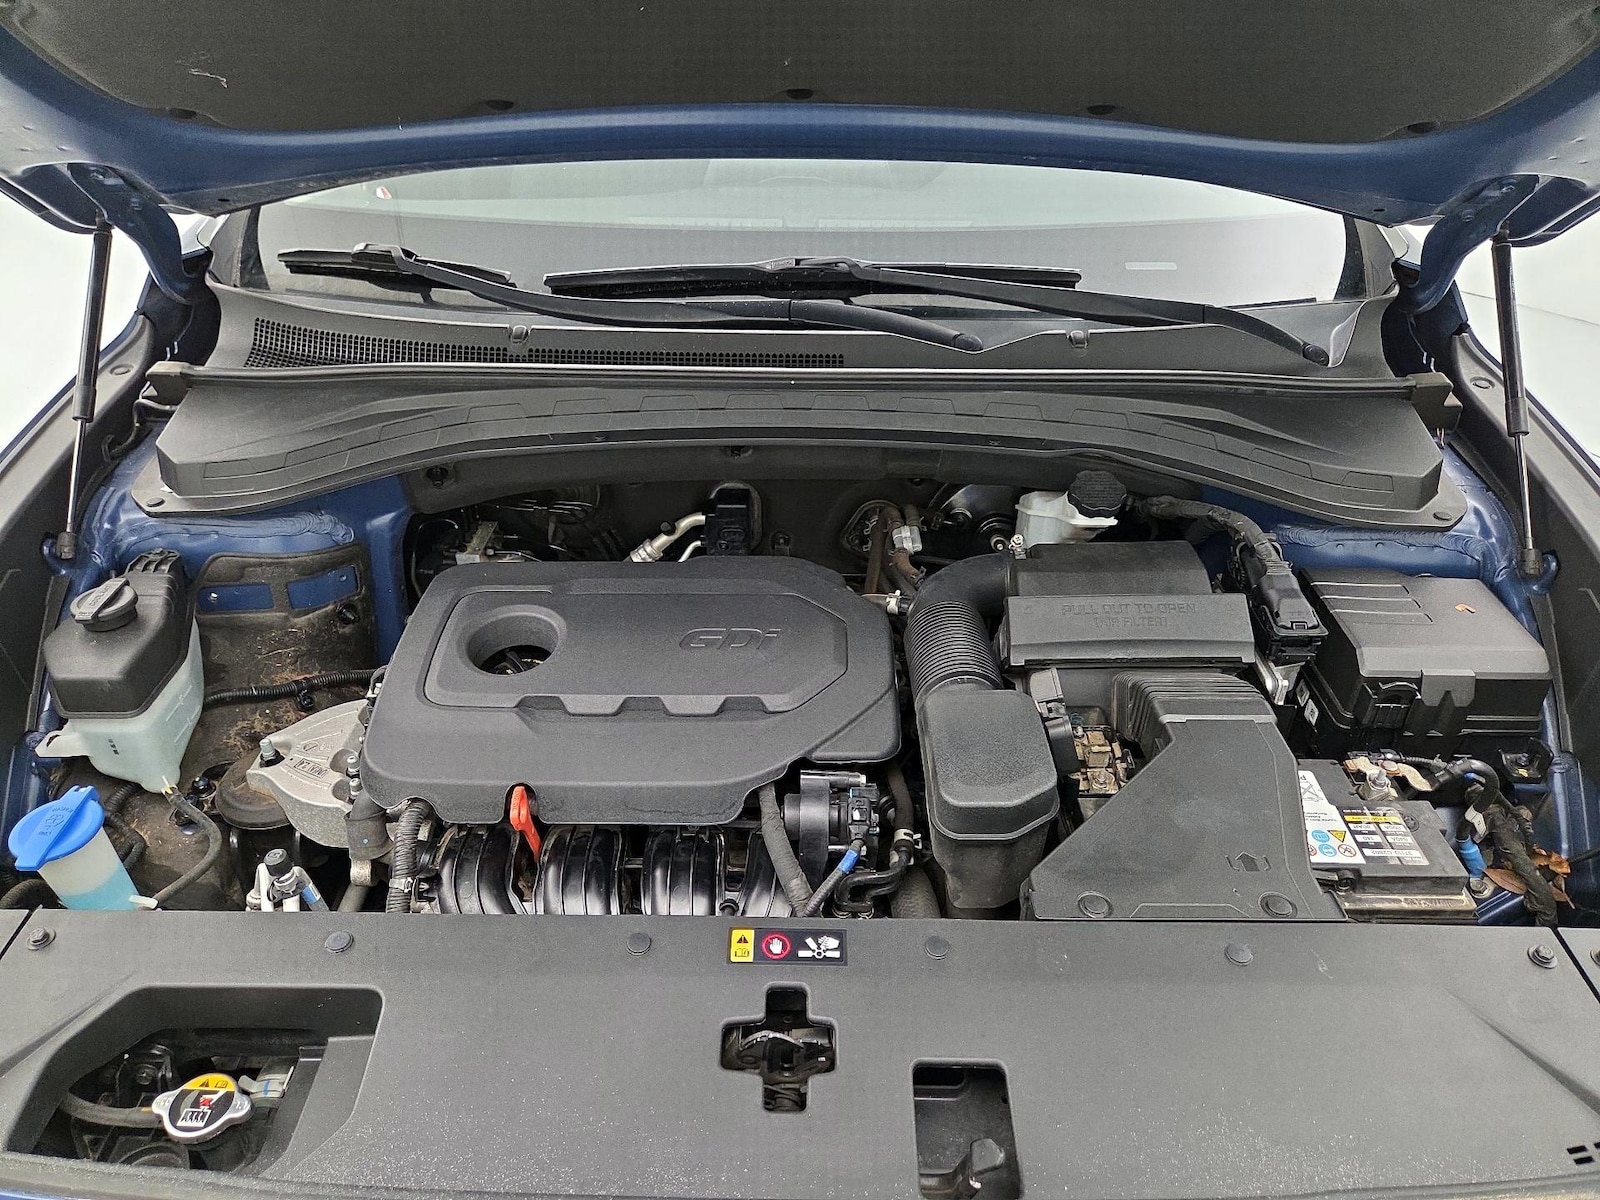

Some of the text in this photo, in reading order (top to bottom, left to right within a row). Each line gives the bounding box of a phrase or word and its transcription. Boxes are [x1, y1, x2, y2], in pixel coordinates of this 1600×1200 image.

[1061, 602, 1196, 615] PULL OUT TO OPEN
[679, 626, 781, 650] GDi
